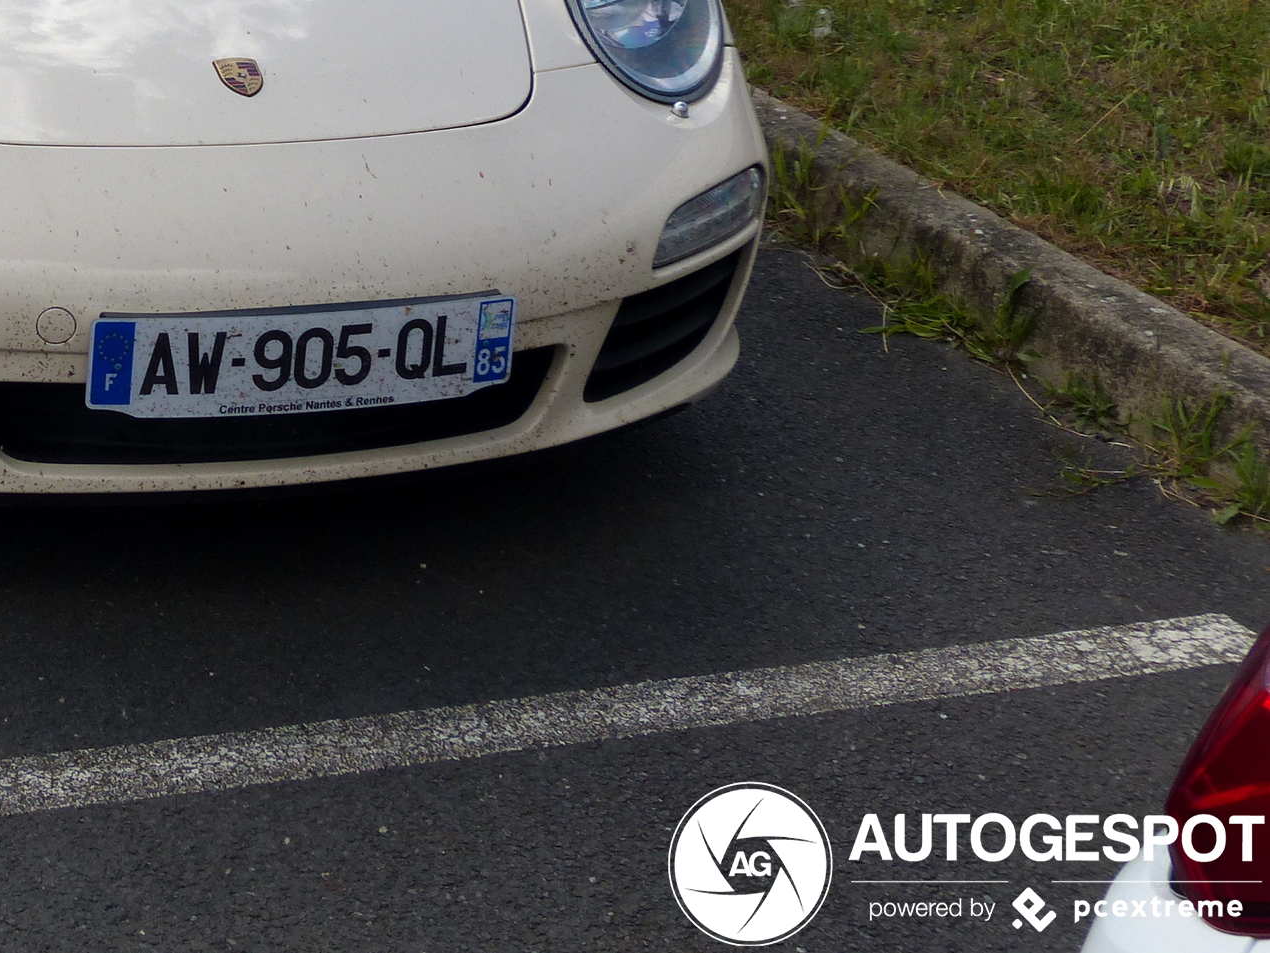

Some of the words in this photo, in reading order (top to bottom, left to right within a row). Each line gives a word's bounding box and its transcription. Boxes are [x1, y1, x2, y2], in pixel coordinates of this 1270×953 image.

[138, 315, 468, 395] AW-905-QL
[476, 346, 506, 376] 85
[103, 373, 118, 391] F
[219, 404, 255, 414] Centre
[258, 402, 302, 413] Porsche
[305, 399, 342, 410] Nantes
[344, 398, 353, 407] &
[356, 394, 395, 406] Rennes
